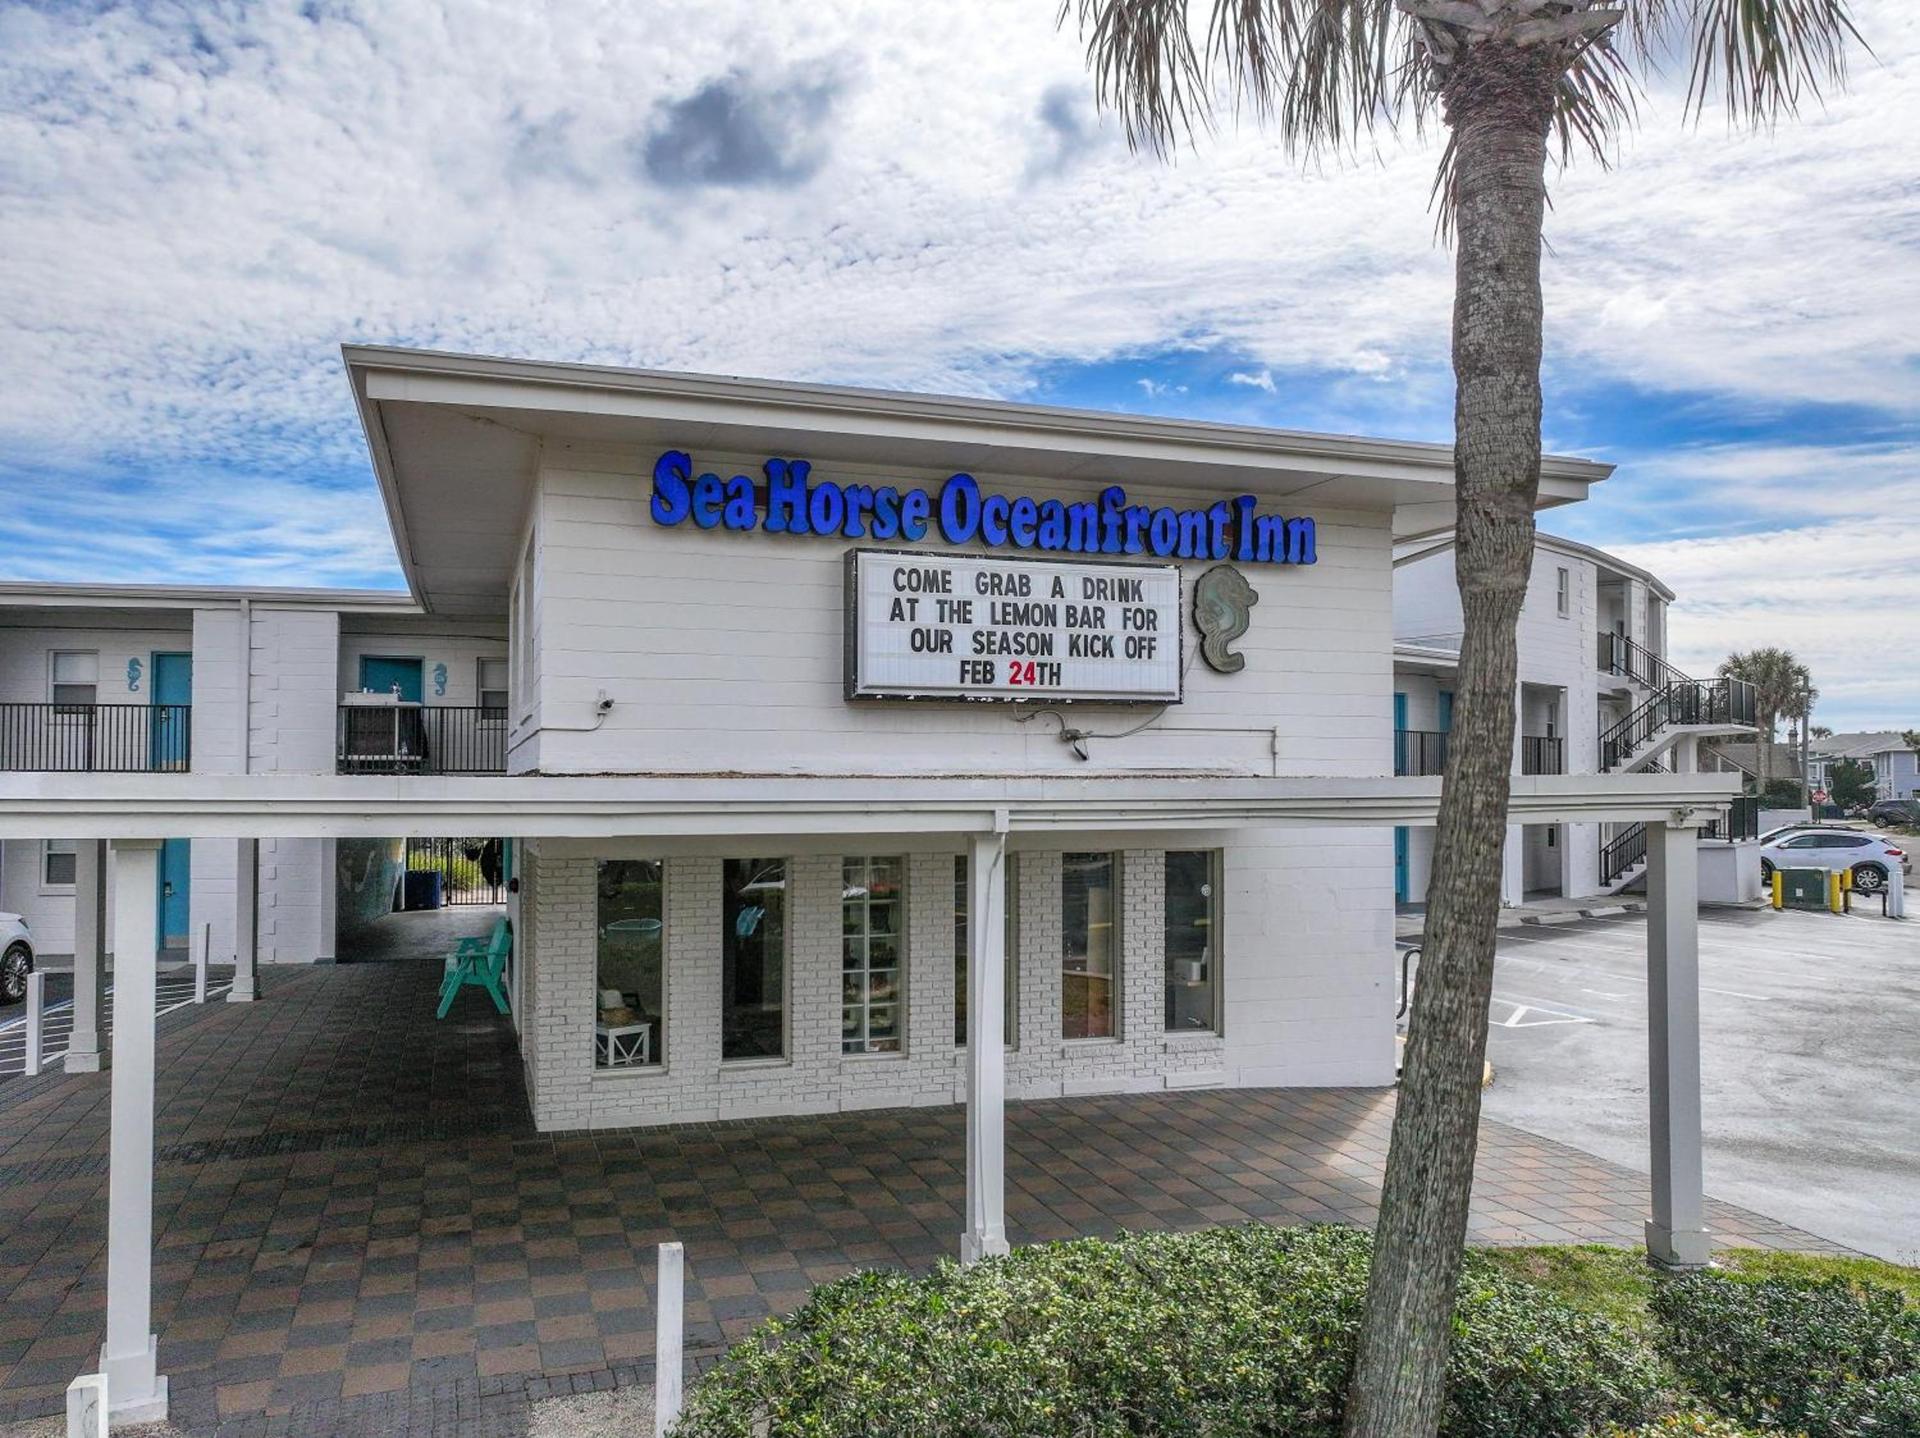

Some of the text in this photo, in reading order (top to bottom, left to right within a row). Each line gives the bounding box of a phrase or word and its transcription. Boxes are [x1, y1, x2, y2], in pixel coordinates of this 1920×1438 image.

[650, 450, 1318, 565] Sea Horse Oceanfront Inn
[892, 567, 1144, 603] COME GRAB A DRINK
[889, 597, 1158, 632] AT THE LEMON BAR FOR
[910, 627, 1157, 660] OUR SEASON KICK OFF
[959, 659, 1062, 687] FEB 24TH
